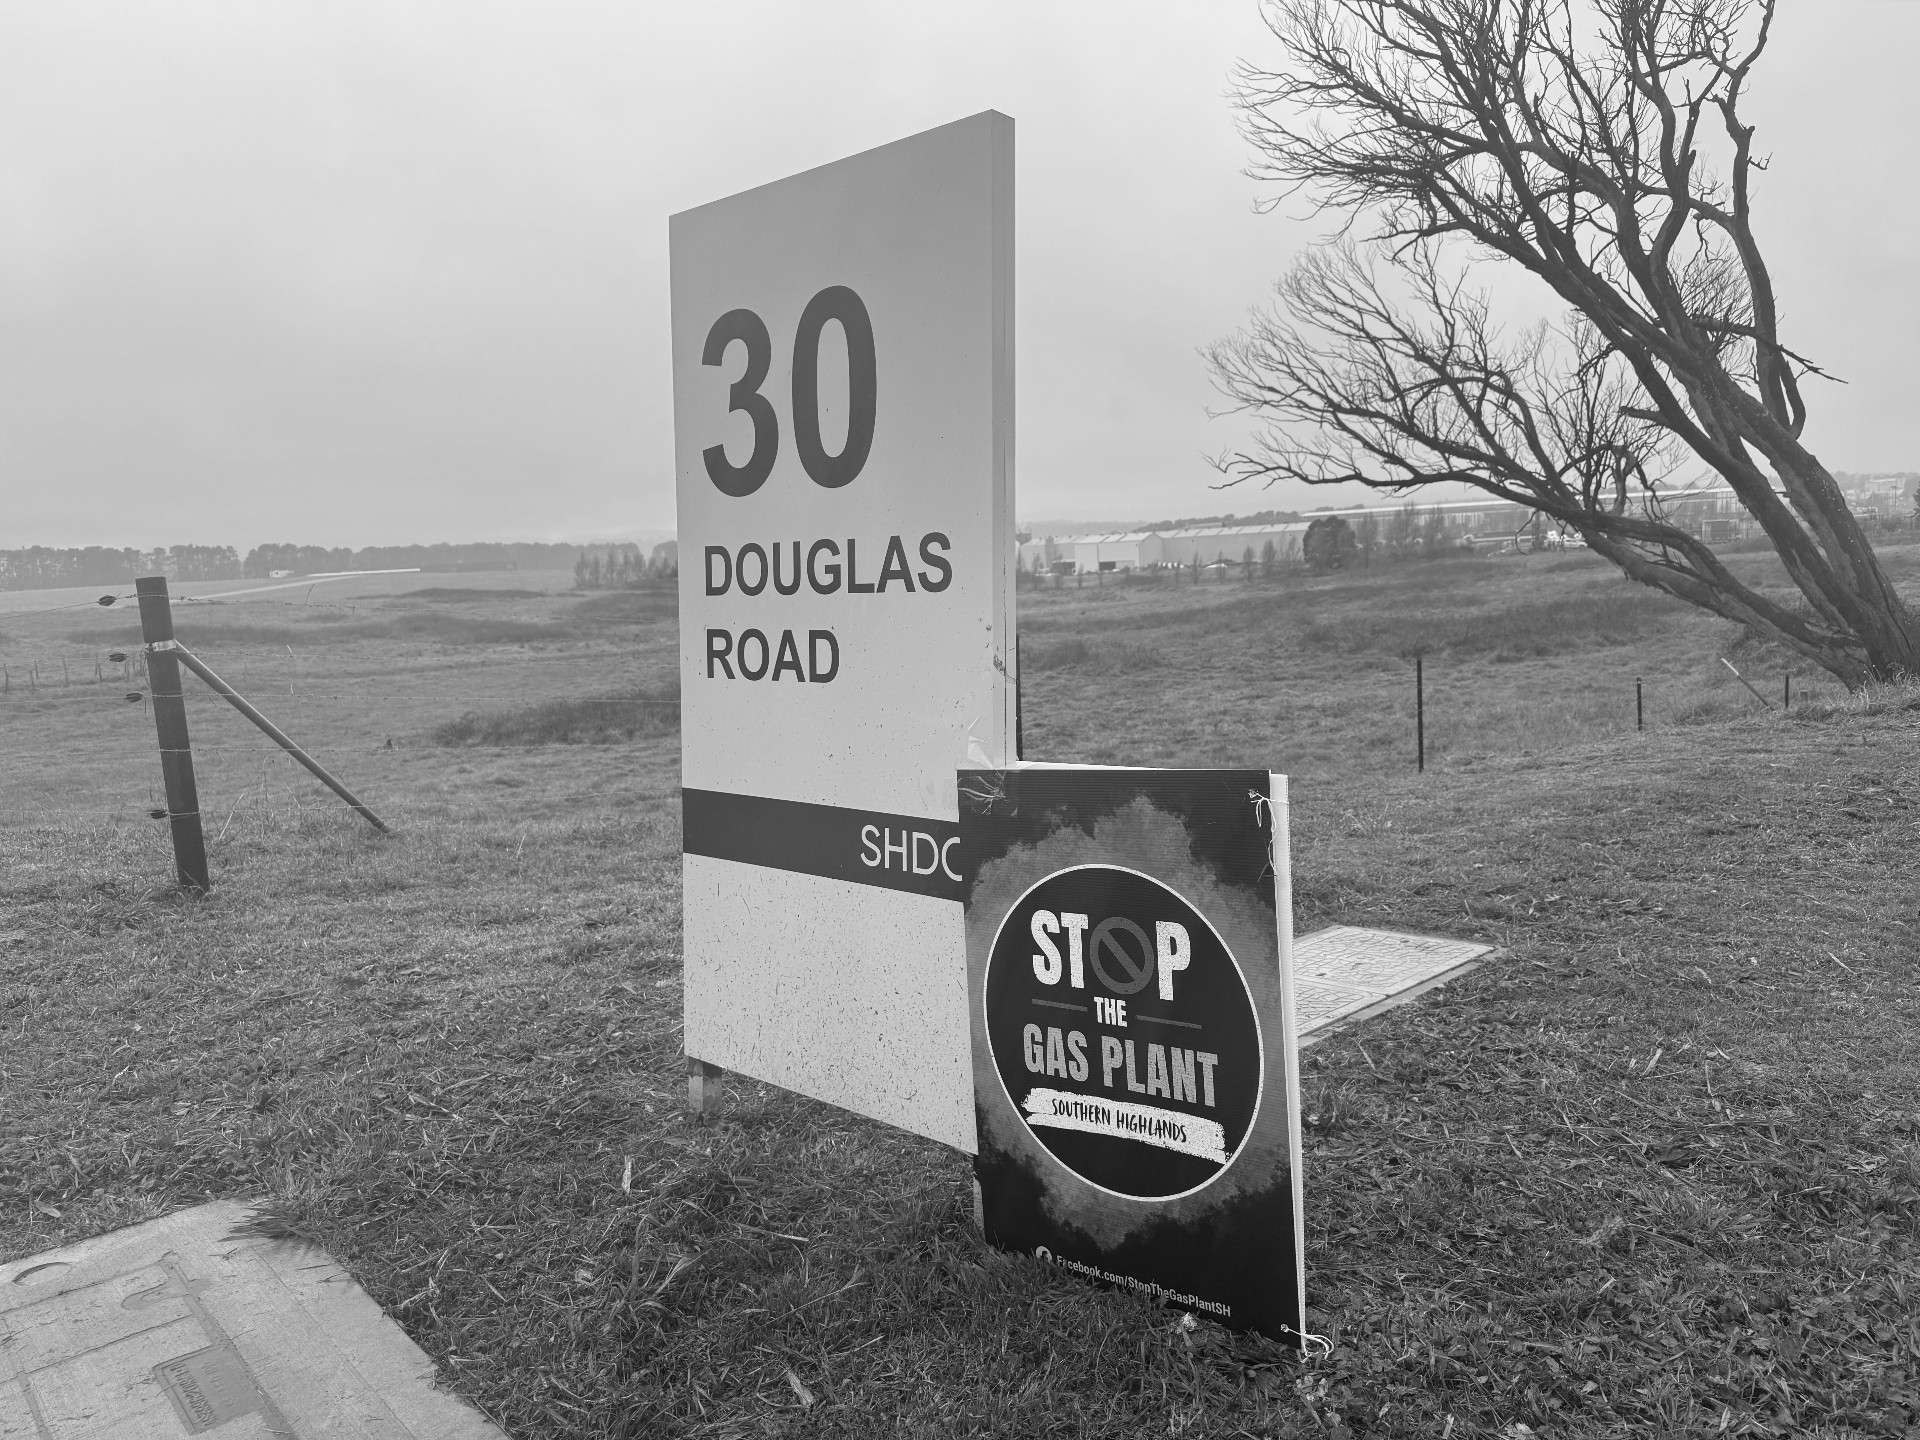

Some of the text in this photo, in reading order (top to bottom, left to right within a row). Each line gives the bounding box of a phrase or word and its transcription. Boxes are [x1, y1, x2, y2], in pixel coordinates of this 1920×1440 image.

[702, 285, 877, 497] 30
[704, 532, 953, 597] DOUGLAS
[706, 628, 840, 684] ROAD
[1094, 997, 1128, 1028] THE
[1023, 1023, 1219, 1108] GAS PLANT
[1052, 1098, 1187, 1143] SOUTHERN HIGHLANDS
